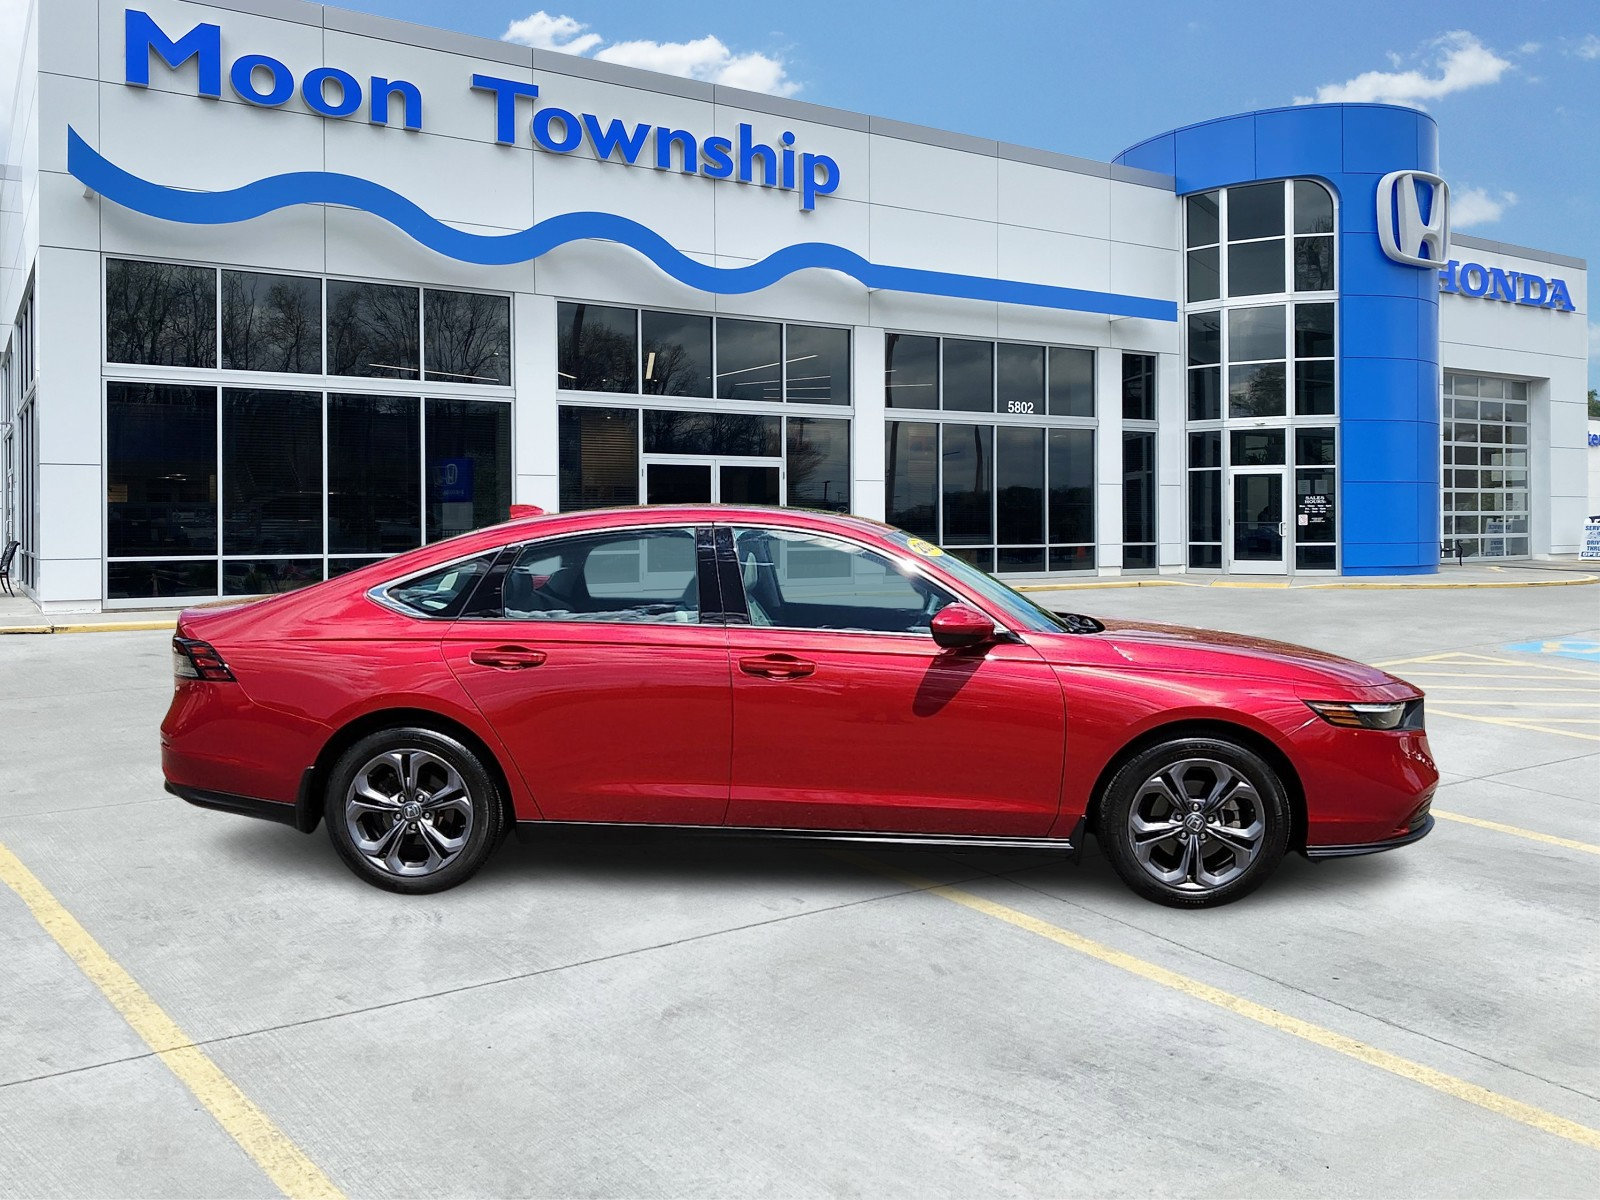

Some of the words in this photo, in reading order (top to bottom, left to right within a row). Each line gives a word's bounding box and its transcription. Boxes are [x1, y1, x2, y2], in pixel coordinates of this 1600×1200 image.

[125, 9, 422, 130] Moon
[471, 74, 841, 212] Township
[1439, 259, 1576, 312] HONDA
[1007, 400, 1034, 414] 5802
